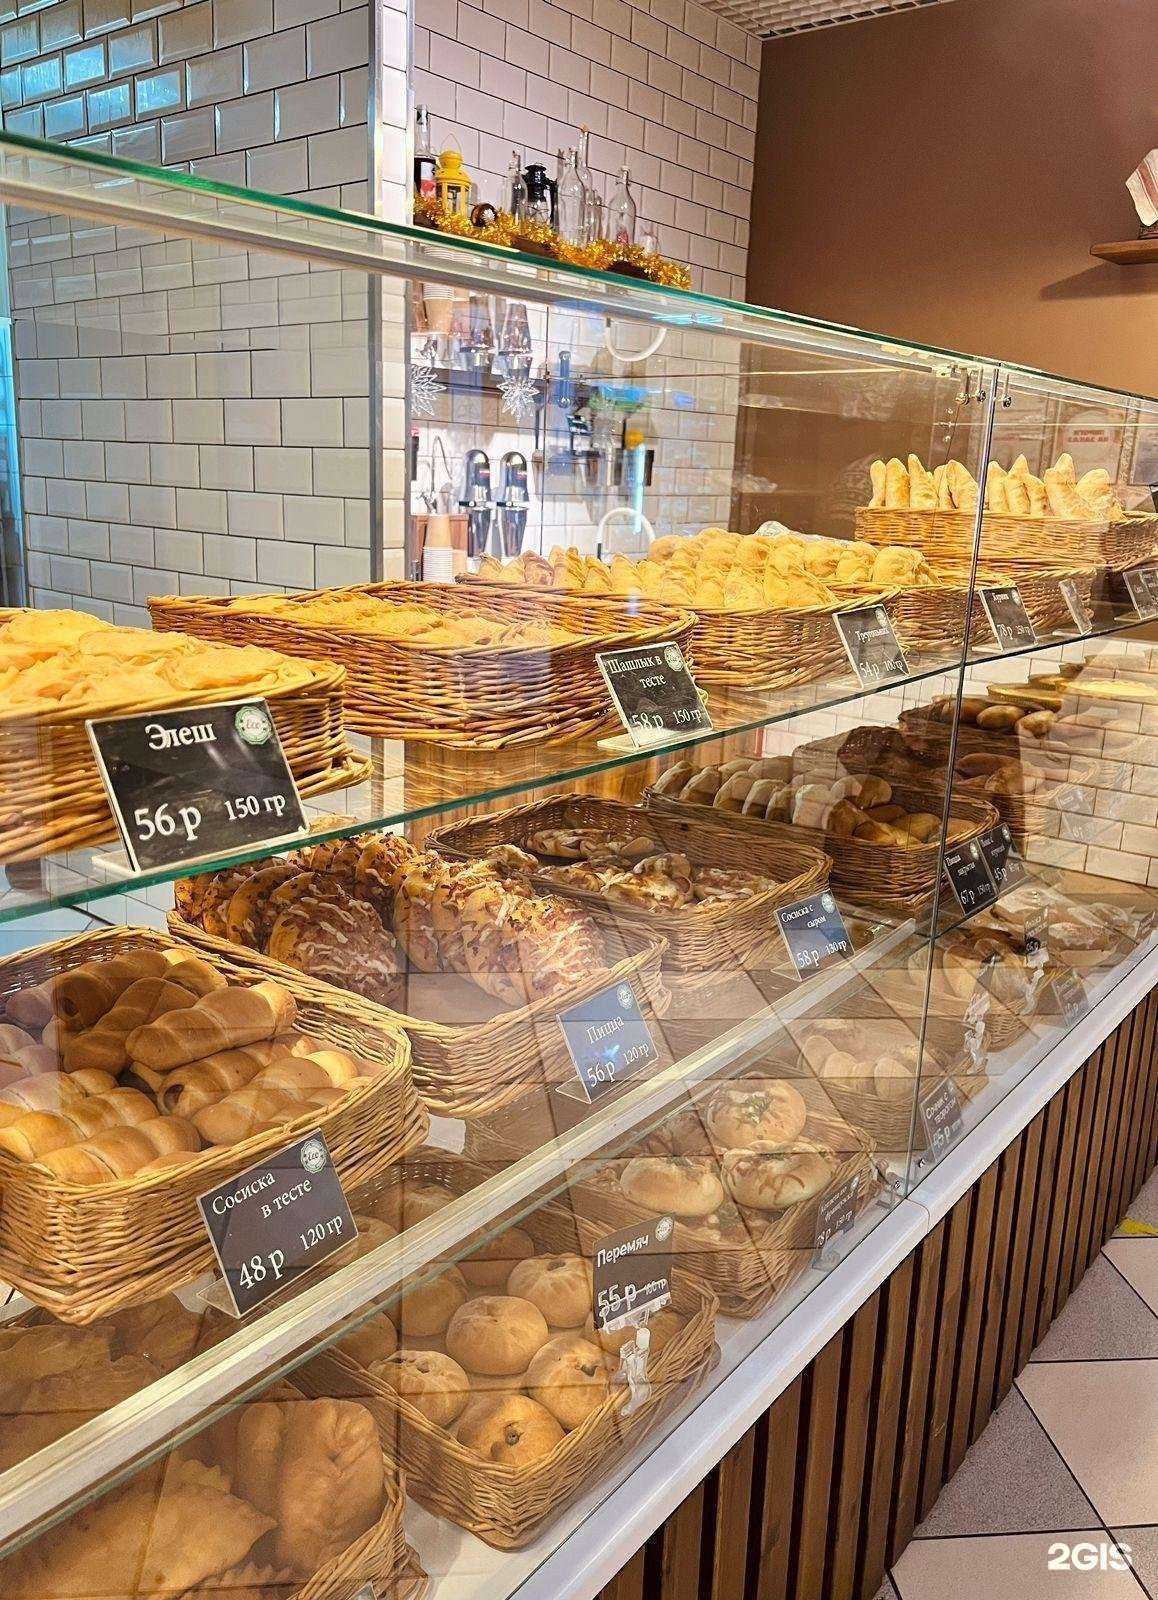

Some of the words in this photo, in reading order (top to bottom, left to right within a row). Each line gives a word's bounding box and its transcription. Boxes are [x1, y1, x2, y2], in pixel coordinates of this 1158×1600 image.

[607, 657, 656, 674] Шашлык
[654, 656, 662, 666] в
[860, 662, 872, 678] 54
[639, 674, 666, 689] тесте
[632, 712, 652, 730] 58
[652, 714, 664, 731] р
[672, 708, 691, 725] 150
[691, 708, 702, 724] гр
[144, 723, 218, 750] Элеш
[223, 795, 260, 822] 150
[262, 794, 286, 817] гр
[134, 803, 176, 842] 56
[178, 804, 202, 842] р
[781, 906, 810, 923] Сосиска
[806, 915, 827, 928] сыром
[797, 950, 812, 968] 58
[812, 949, 820, 967] р
[825, 942, 838, 955] 130
[838, 940, 847, 952] гр
[586, 1016, 624, 1044] Пицца
[622, 1045, 639, 1066] 120
[639, 1042, 650, 1058] гр
[586, 1062, 605, 1088] 56
[604, 1061, 616, 1083] р
[212, 1172, 276, 1216] Сосиска
[260, 1204, 272, 1220] в
[272, 1178, 312, 1211] тесте
[300, 1223, 326, 1252] 120
[326, 1215, 344, 1236] гр
[597, 1234, 649, 1268] Перемяч
[239, 1254, 266, 1290] 48
[268, 1249, 284, 1280] р
[598, 1284, 621, 1318] 55
[624, 1283, 637, 1311] р
